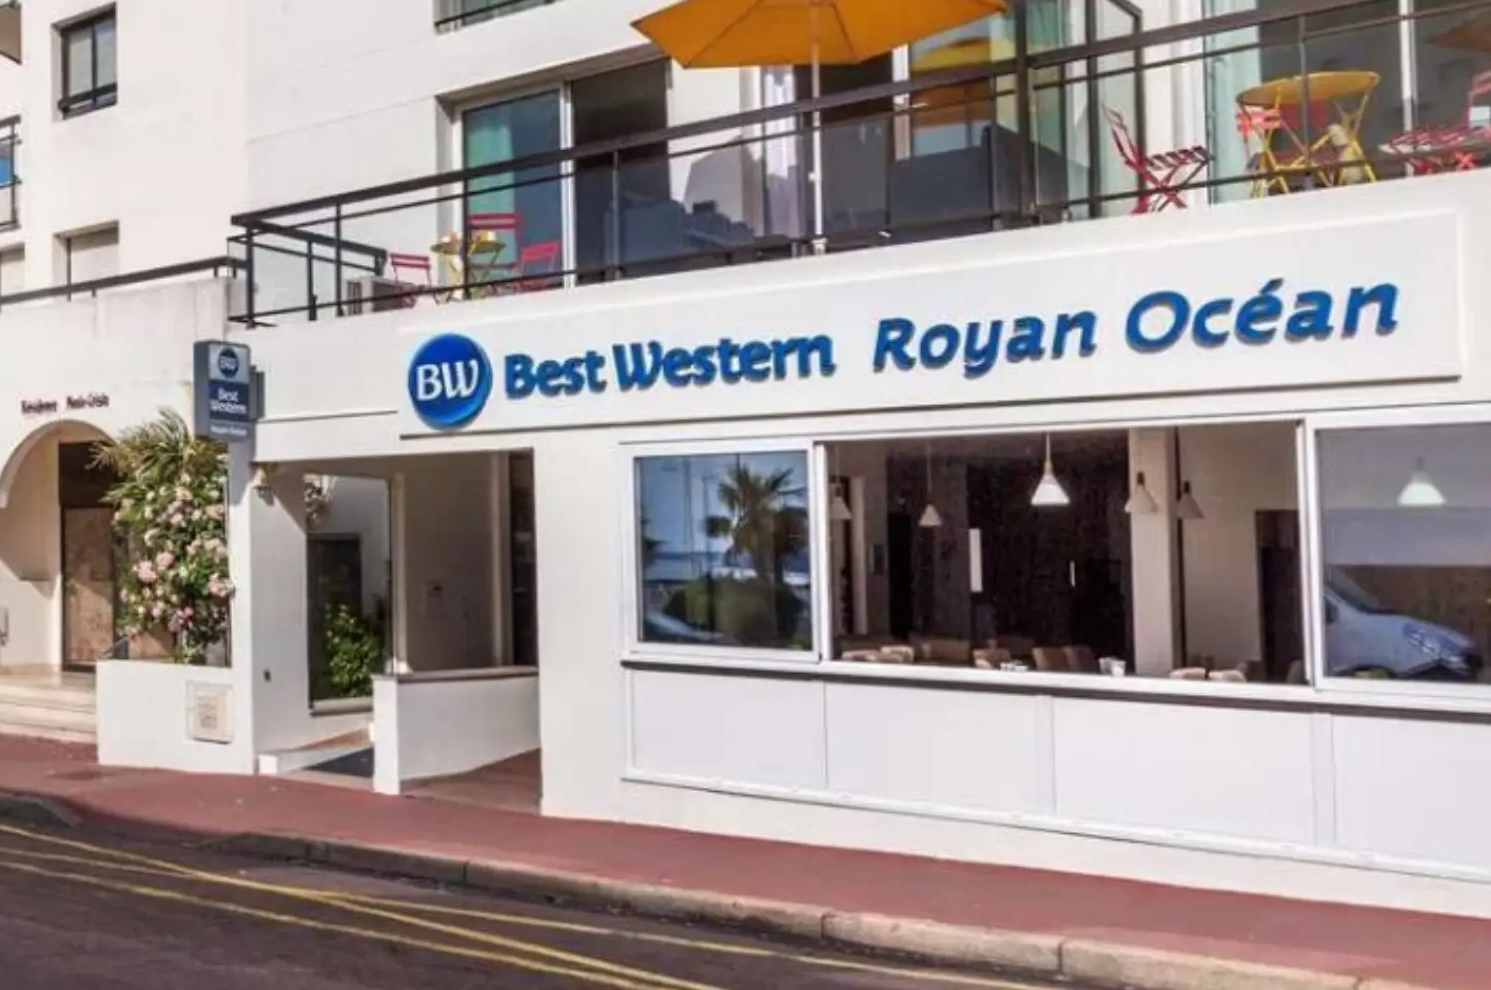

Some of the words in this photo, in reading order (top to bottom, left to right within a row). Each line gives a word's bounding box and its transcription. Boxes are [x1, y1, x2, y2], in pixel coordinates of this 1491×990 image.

[415, 357, 479, 402] BW
[504, 349, 608, 400] Best
[612, 334, 837, 392] Western
[873, 308, 1098, 380] Royan
[1125, 277, 1400, 354] Océan
